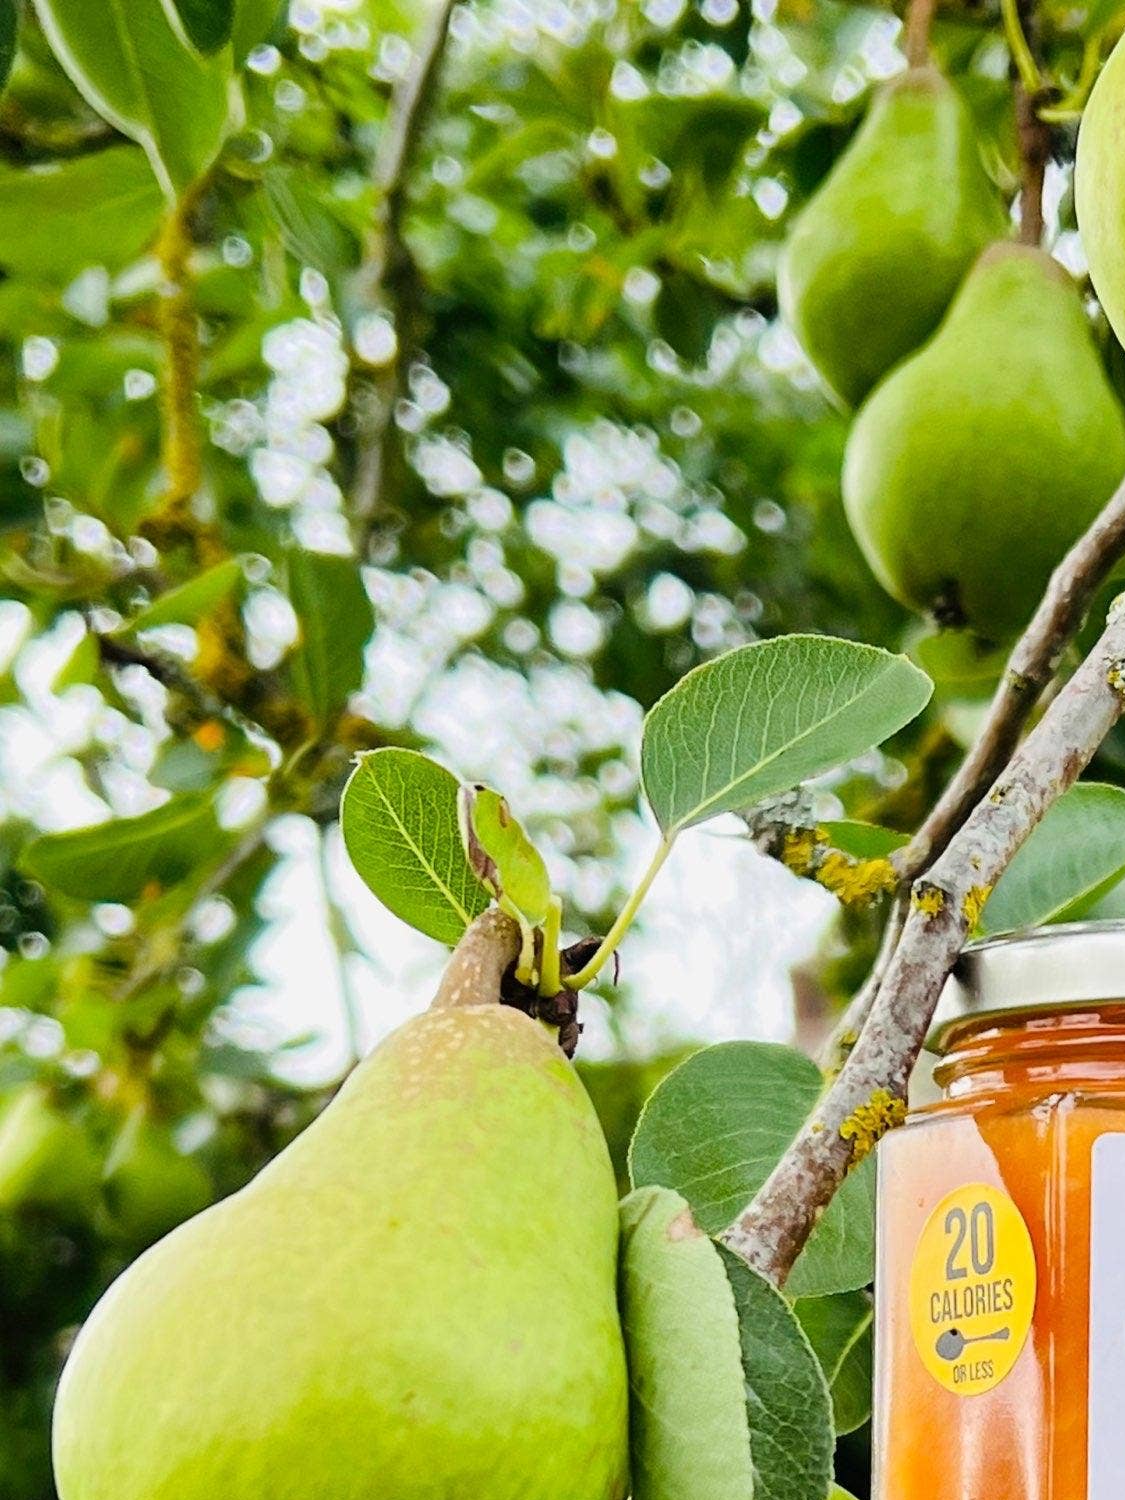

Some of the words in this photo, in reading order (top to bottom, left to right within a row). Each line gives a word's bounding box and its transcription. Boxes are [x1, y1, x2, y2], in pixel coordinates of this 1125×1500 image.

[944, 1201, 995, 1281] 20
[930, 1278, 1014, 1324] CALORIES
[952, 1363, 968, 1384] OR
[969, 1359, 994, 1380] LESS
